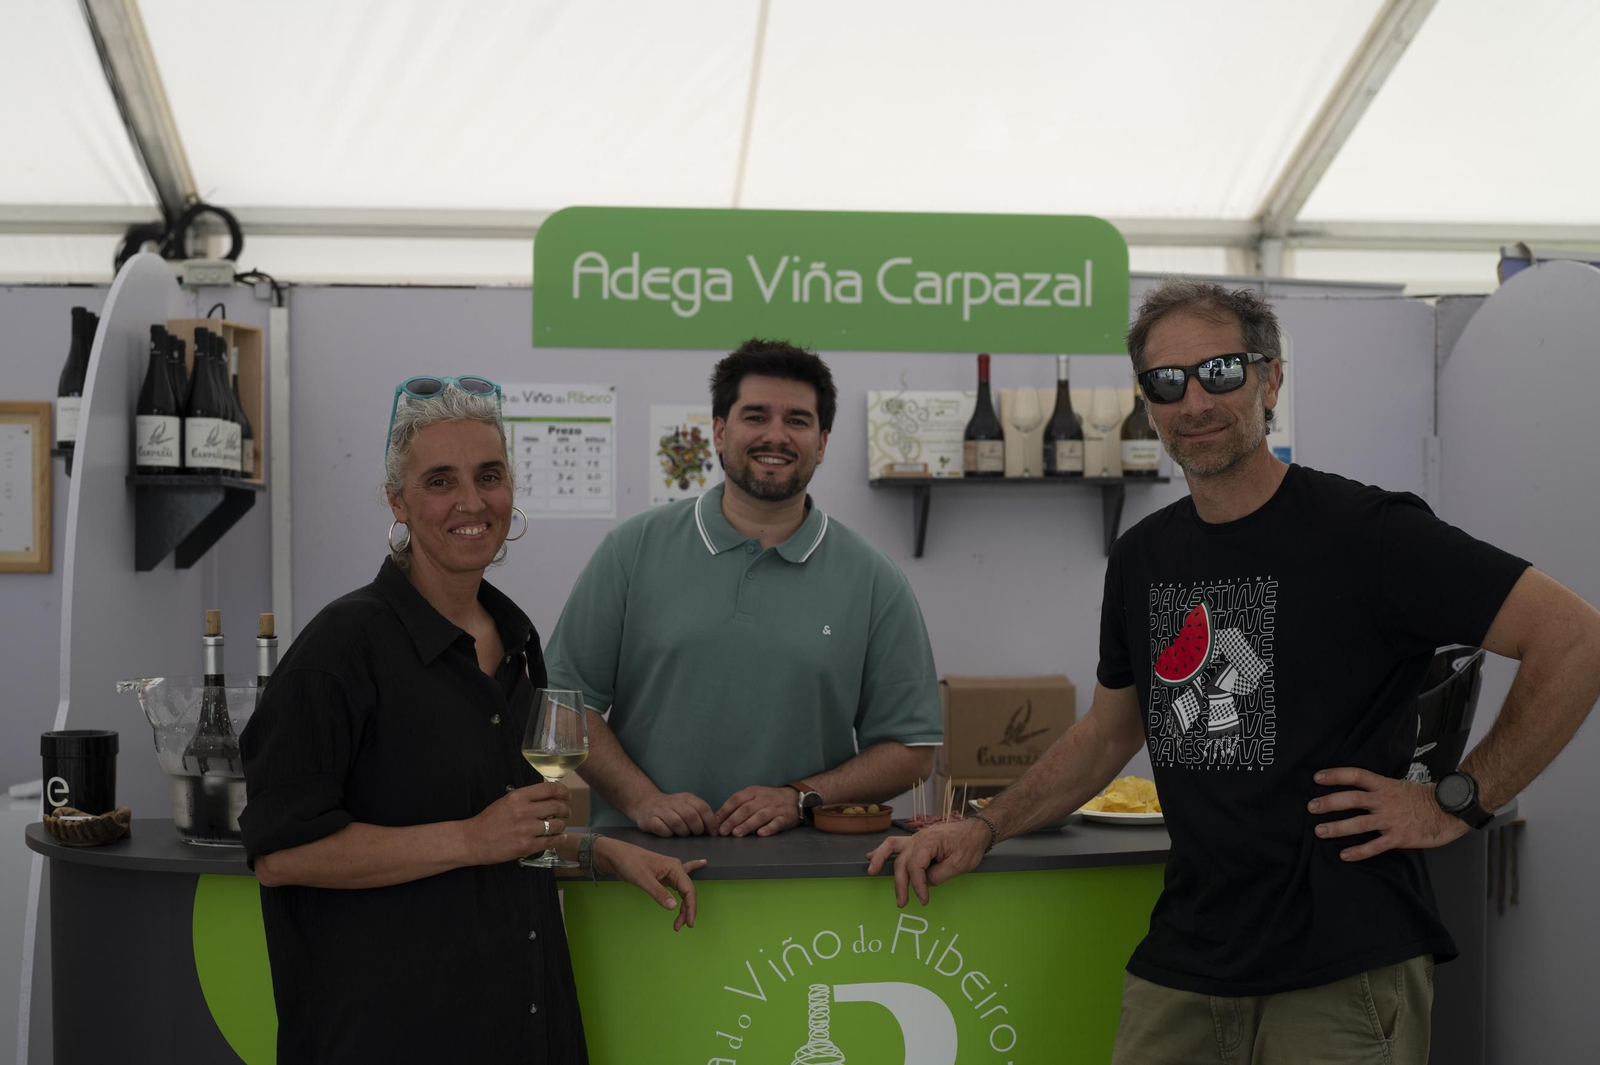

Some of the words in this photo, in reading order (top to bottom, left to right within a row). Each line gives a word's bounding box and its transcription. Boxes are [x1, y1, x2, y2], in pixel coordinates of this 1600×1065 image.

[573, 251, 733, 318] Adega
[746, 255, 862, 304] Viña
[876, 257, 1092, 321] Carpazal
[522, 390, 553, 404] Viño
[567, 391, 612, 404] Ribeiro
[548, 425, 582, 436] Prezo
[1149, 581, 1279, 613] PALESTINE
[852, 925, 883, 954] do
[723, 930, 842, 1002] Viño
[891, 912, 1018, 1053] Ribeiro
[716, 1014, 752, 1050] do
